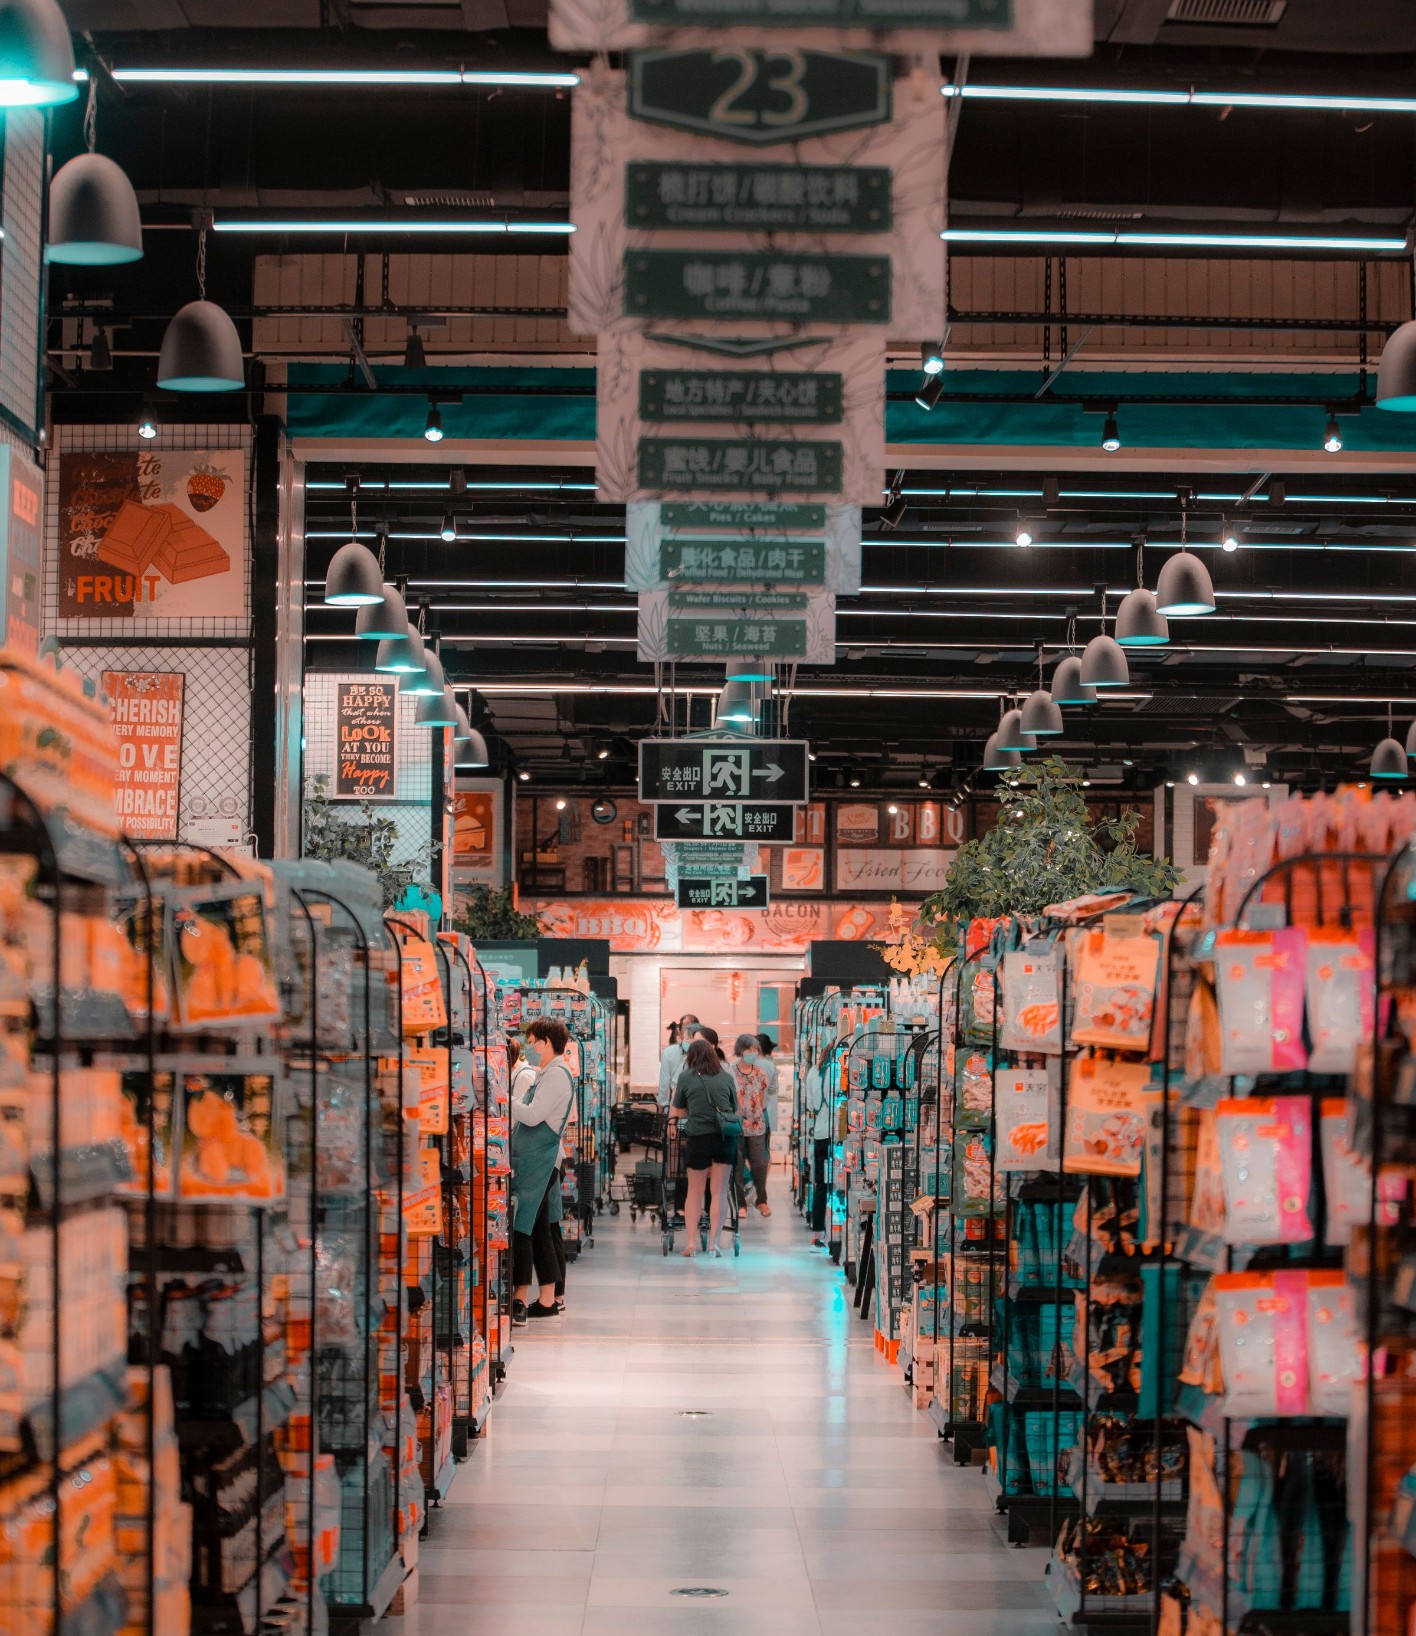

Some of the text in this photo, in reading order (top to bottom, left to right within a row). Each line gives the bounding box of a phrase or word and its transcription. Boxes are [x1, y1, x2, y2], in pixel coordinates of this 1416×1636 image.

[709, 51, 809, 126] 23
[709, 512, 732, 523] Pies
[743, 513, 776, 523] Cakes
[77, 575, 161, 603] FRUIT
[686, 595, 711, 603] Wafer
[713, 595, 746, 603] Biscuits
[756, 595, 790, 604] Cookies
[702, 642, 722, 651] Nuts
[732, 642, 770, 651] Seaweed
[350, 686, 384, 696] BE SO
[343, 695, 391, 707] HAPPY
[109, 698, 180, 724] CHERISH
[111, 724, 179, 738] VERY MEMORY
[342, 742, 390, 753] AT YOU
[120, 743, 178, 768] OVE
[361, 753, 391, 764] BECOME
[115, 770, 176, 783] ERY MOMENT
[341, 761, 390, 788] Happy
[661, 767, 700, 782] 安全出口
[353, 786, 375, 795] TOO
[666, 782, 697, 791] EXIT
[114, 788, 176, 815] MBRACE
[126, 816, 175, 830] POSSIBILITY
[744, 812, 777, 825] 安全出口
[748, 824, 774, 833] EXIT
[894, 808, 964, 844] BBQ
[843, 859, 955, 884] Fried Foo
[688, 889, 711, 898] 安全出口
[761, 904, 821, 918] BACON
[577, 917, 647, 937] BBQ
